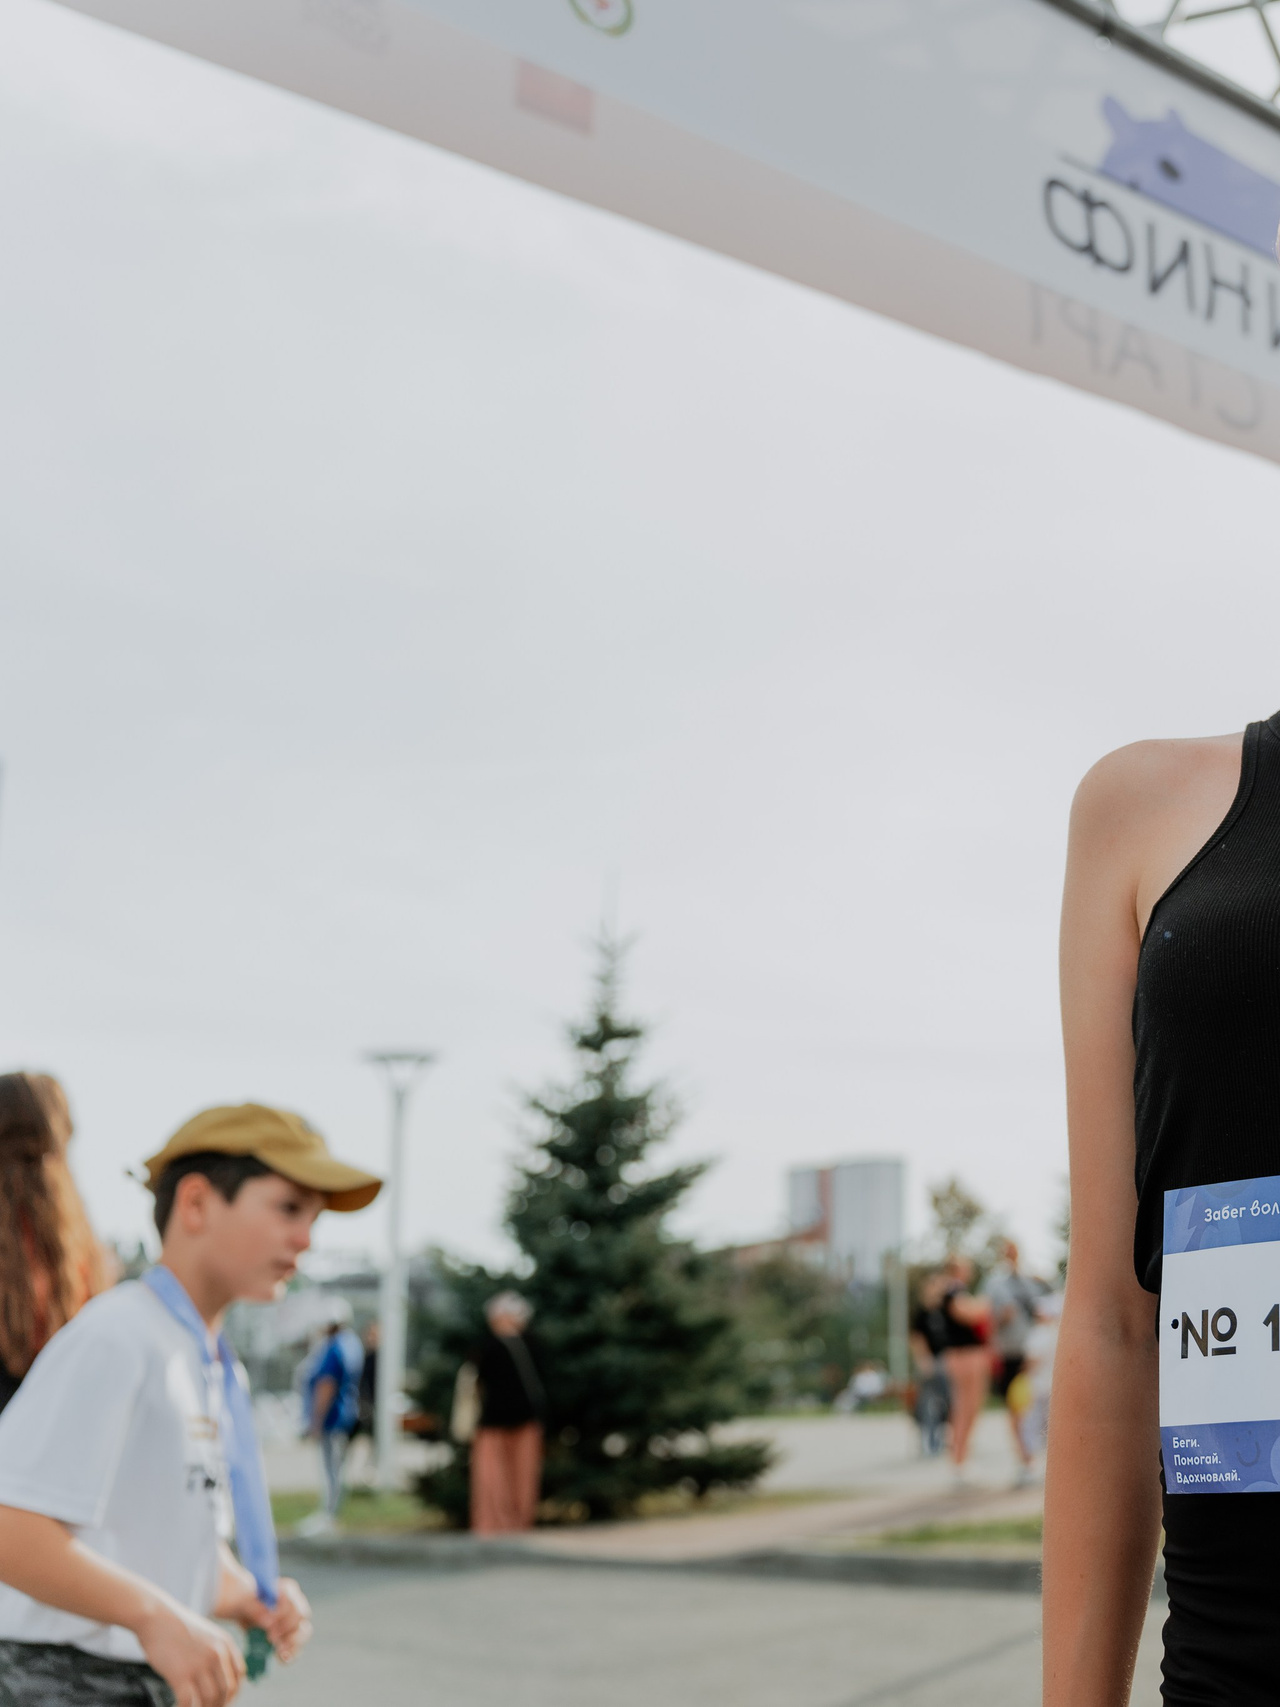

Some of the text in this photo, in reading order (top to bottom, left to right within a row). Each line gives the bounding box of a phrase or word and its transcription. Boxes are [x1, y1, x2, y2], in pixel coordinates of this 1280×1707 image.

[1204, 1206, 1246, 1222] Забег
[1180, 1307, 1237, 1359] №
[1172, 1436, 1200, 1449] Беги.
[1173, 1452, 1221, 1466] Помогай.
[1176, 1469, 1241, 1485] Вдохновляй.
